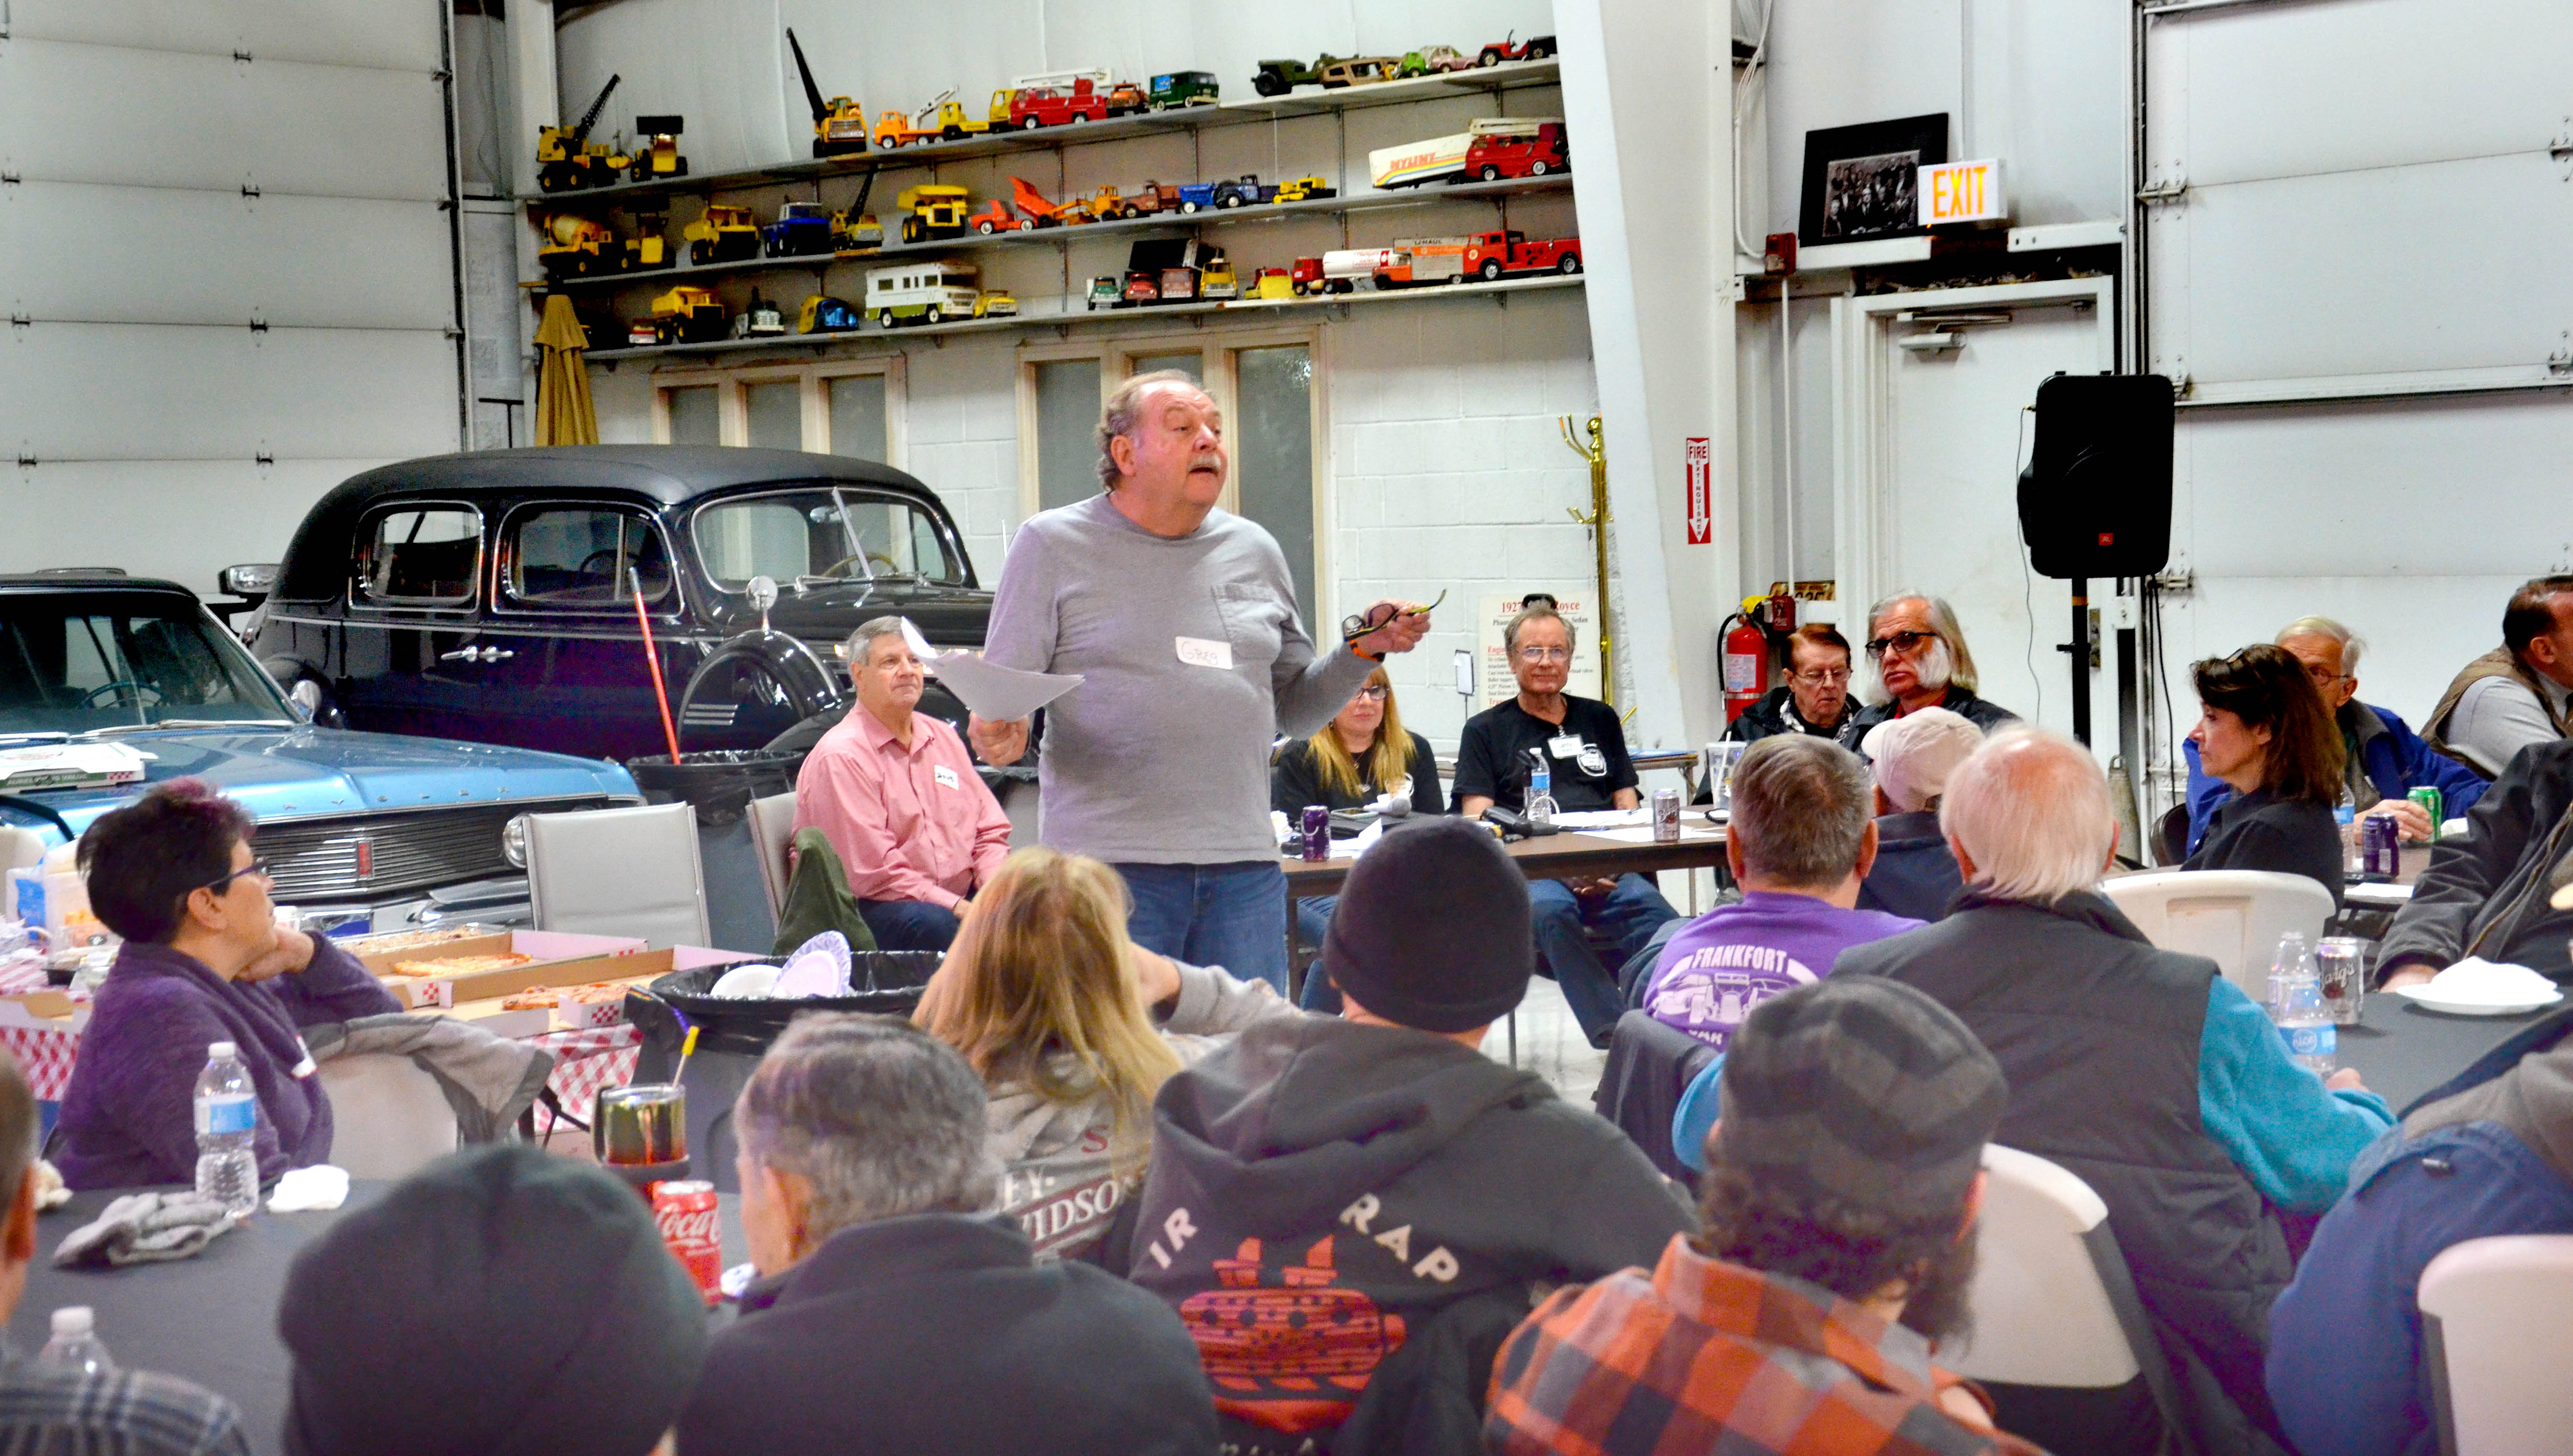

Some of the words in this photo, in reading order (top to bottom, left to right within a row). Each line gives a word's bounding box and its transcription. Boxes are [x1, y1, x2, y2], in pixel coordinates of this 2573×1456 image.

[1933, 166, 1987, 218] EXIT
[1689, 446, 1707, 459] FIRE
[1692, 944, 1787, 973] FRANKFORT
[1150, 1208, 1198, 1269] IR
[1339, 1193, 1460, 1283] RAP
